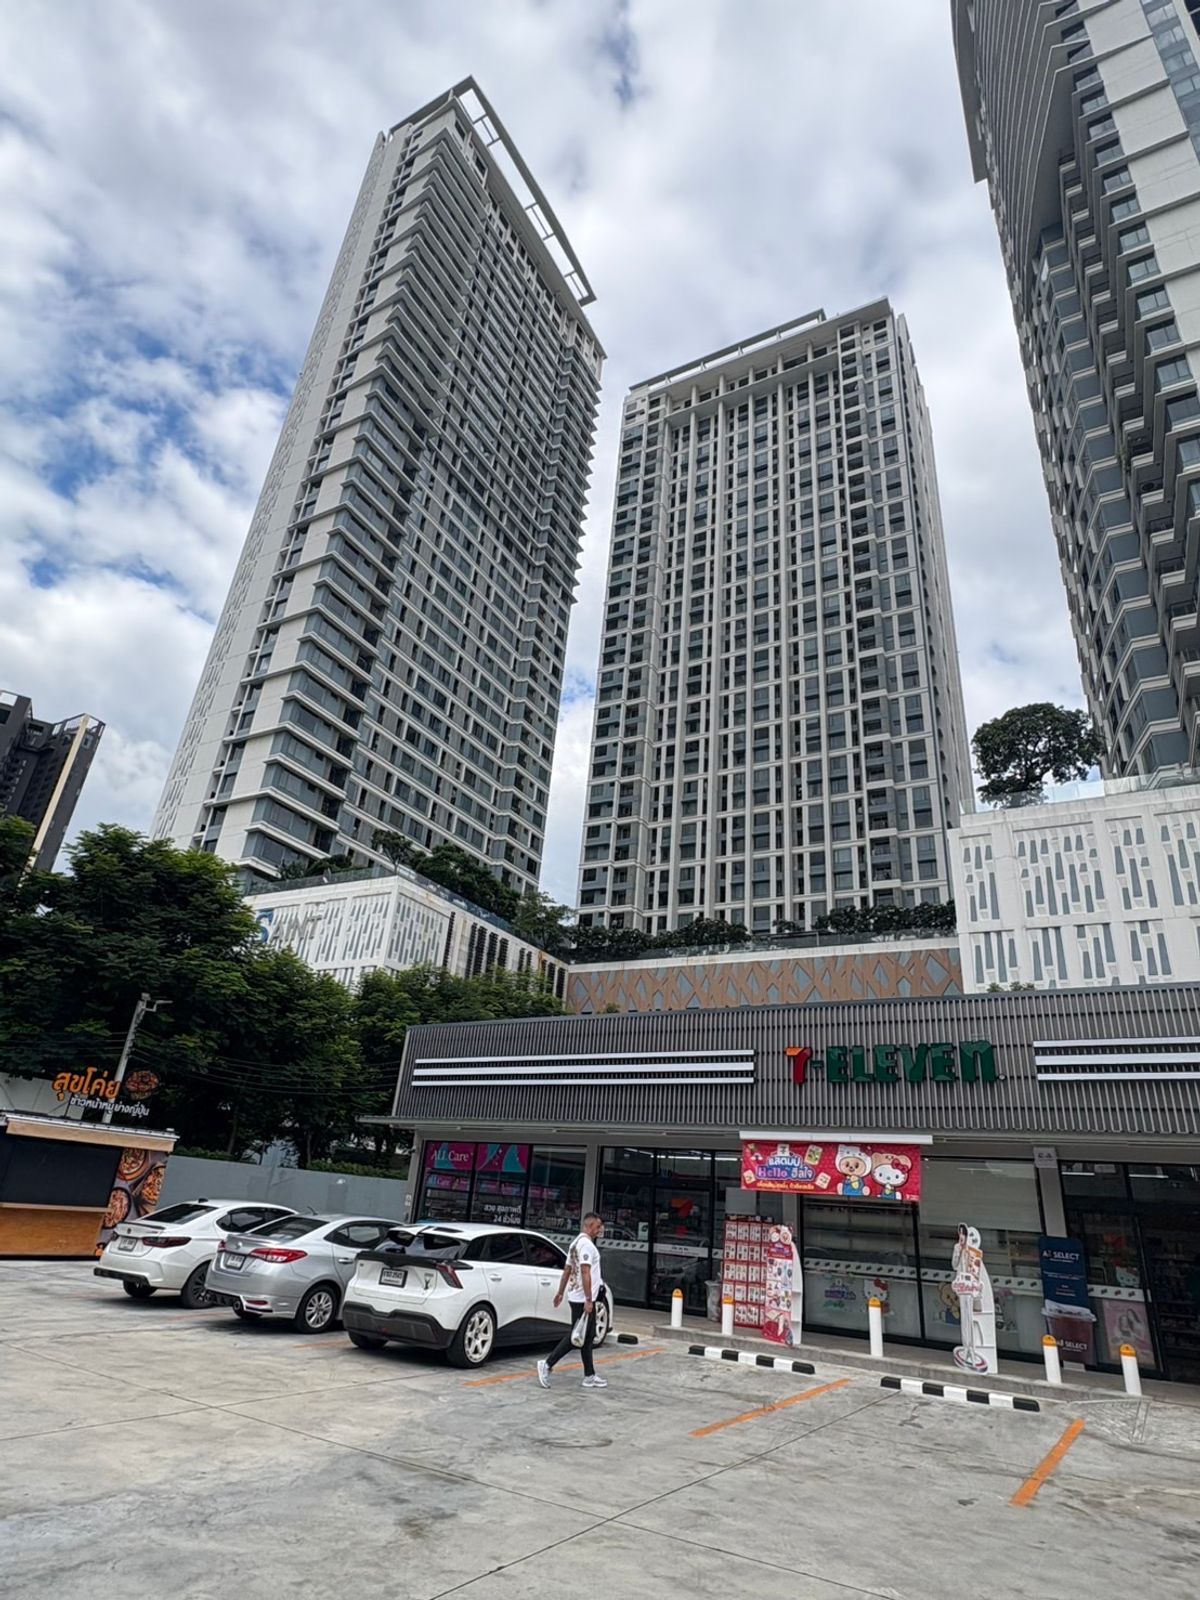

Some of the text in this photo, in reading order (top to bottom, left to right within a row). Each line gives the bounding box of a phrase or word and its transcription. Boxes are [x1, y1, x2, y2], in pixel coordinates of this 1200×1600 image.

[52, 1066, 121, 1101] สุขโค่ย
[448, 1150, 470, 1162] Care
[758, 1167, 788, 1178] Hello
[1053, 1251, 1080, 1261] SELECT
[1065, 1340, 1088, 1350] SELECT
